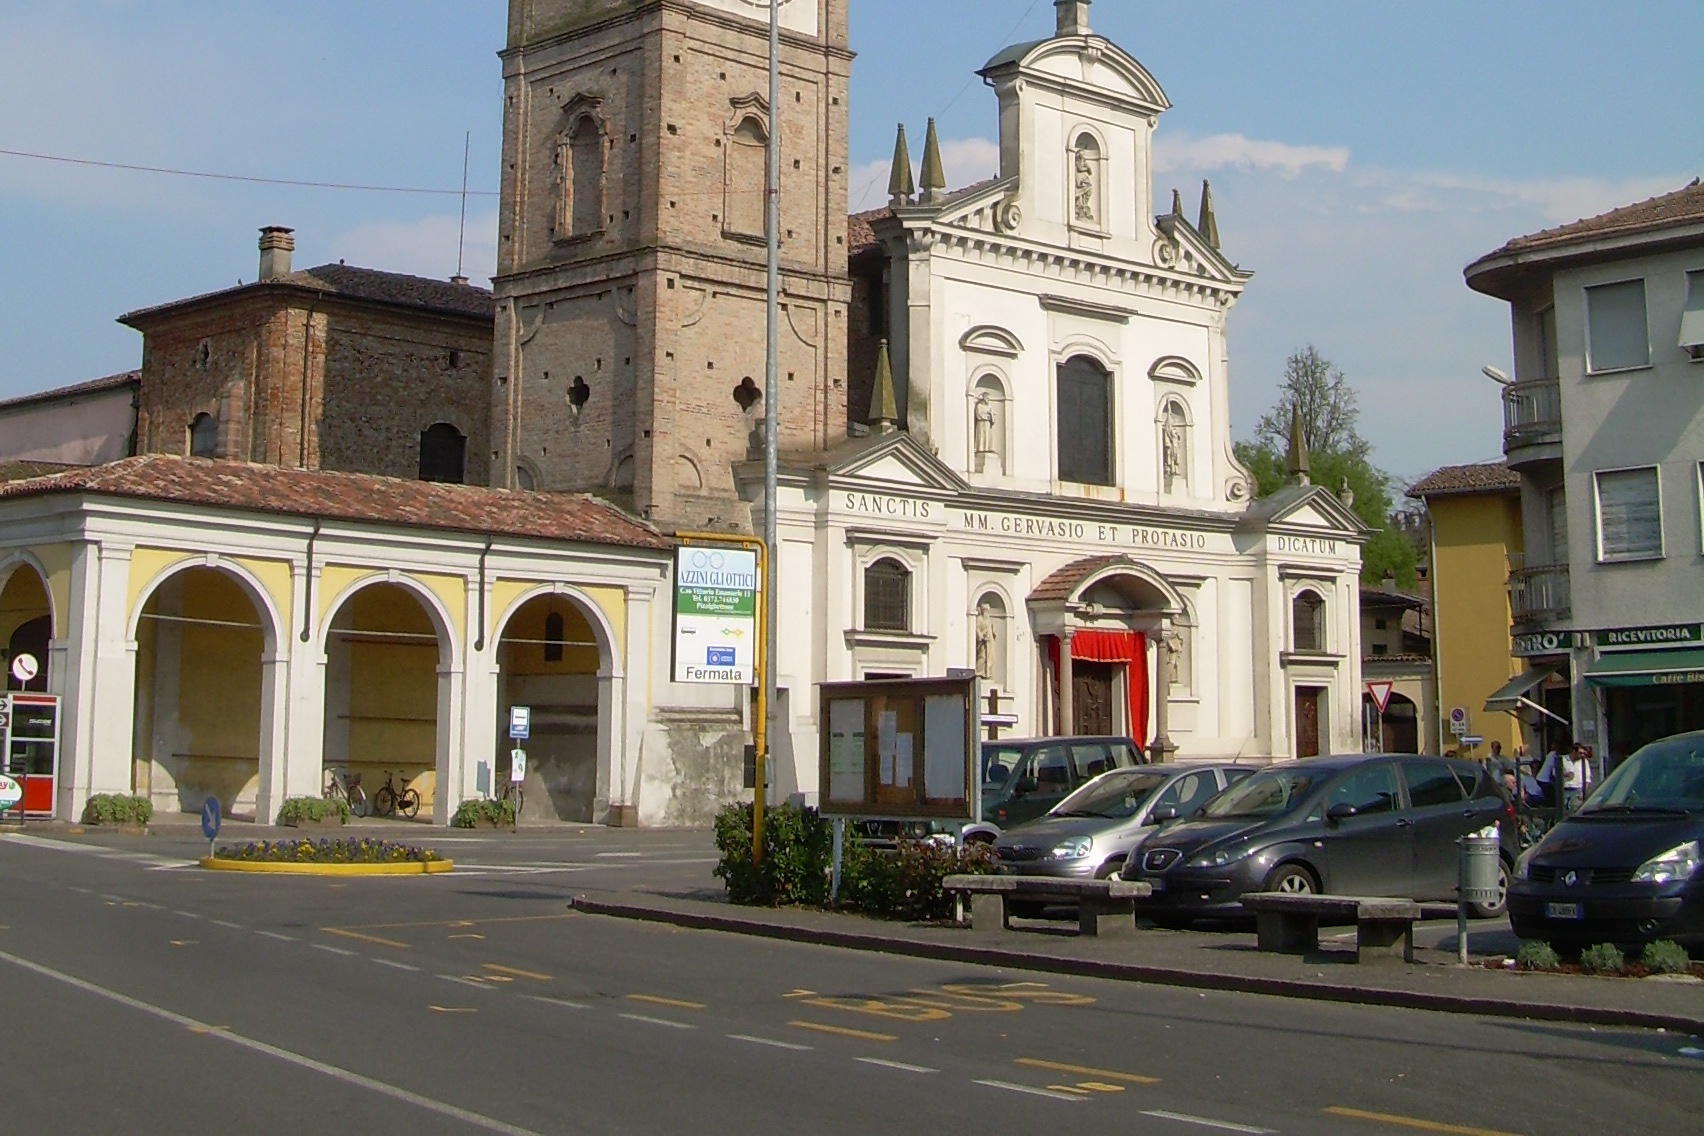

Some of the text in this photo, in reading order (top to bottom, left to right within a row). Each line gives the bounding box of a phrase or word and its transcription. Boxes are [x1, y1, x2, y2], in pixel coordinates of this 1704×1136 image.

[846, 493, 930, 517] SANCTIS
[1001, 516, 1084, 538] GERVASIO
[1098, 525, 1118, 541] ET
[1132, 528, 1206, 548] PROTASIO
[1277, 536, 1336, 554] DICATUM
[680, 570, 753, 587] AZZINI GLI OTTICI
[686, 666, 743, 680] Fermata
[800, 983, 1097, 1022] BUS
